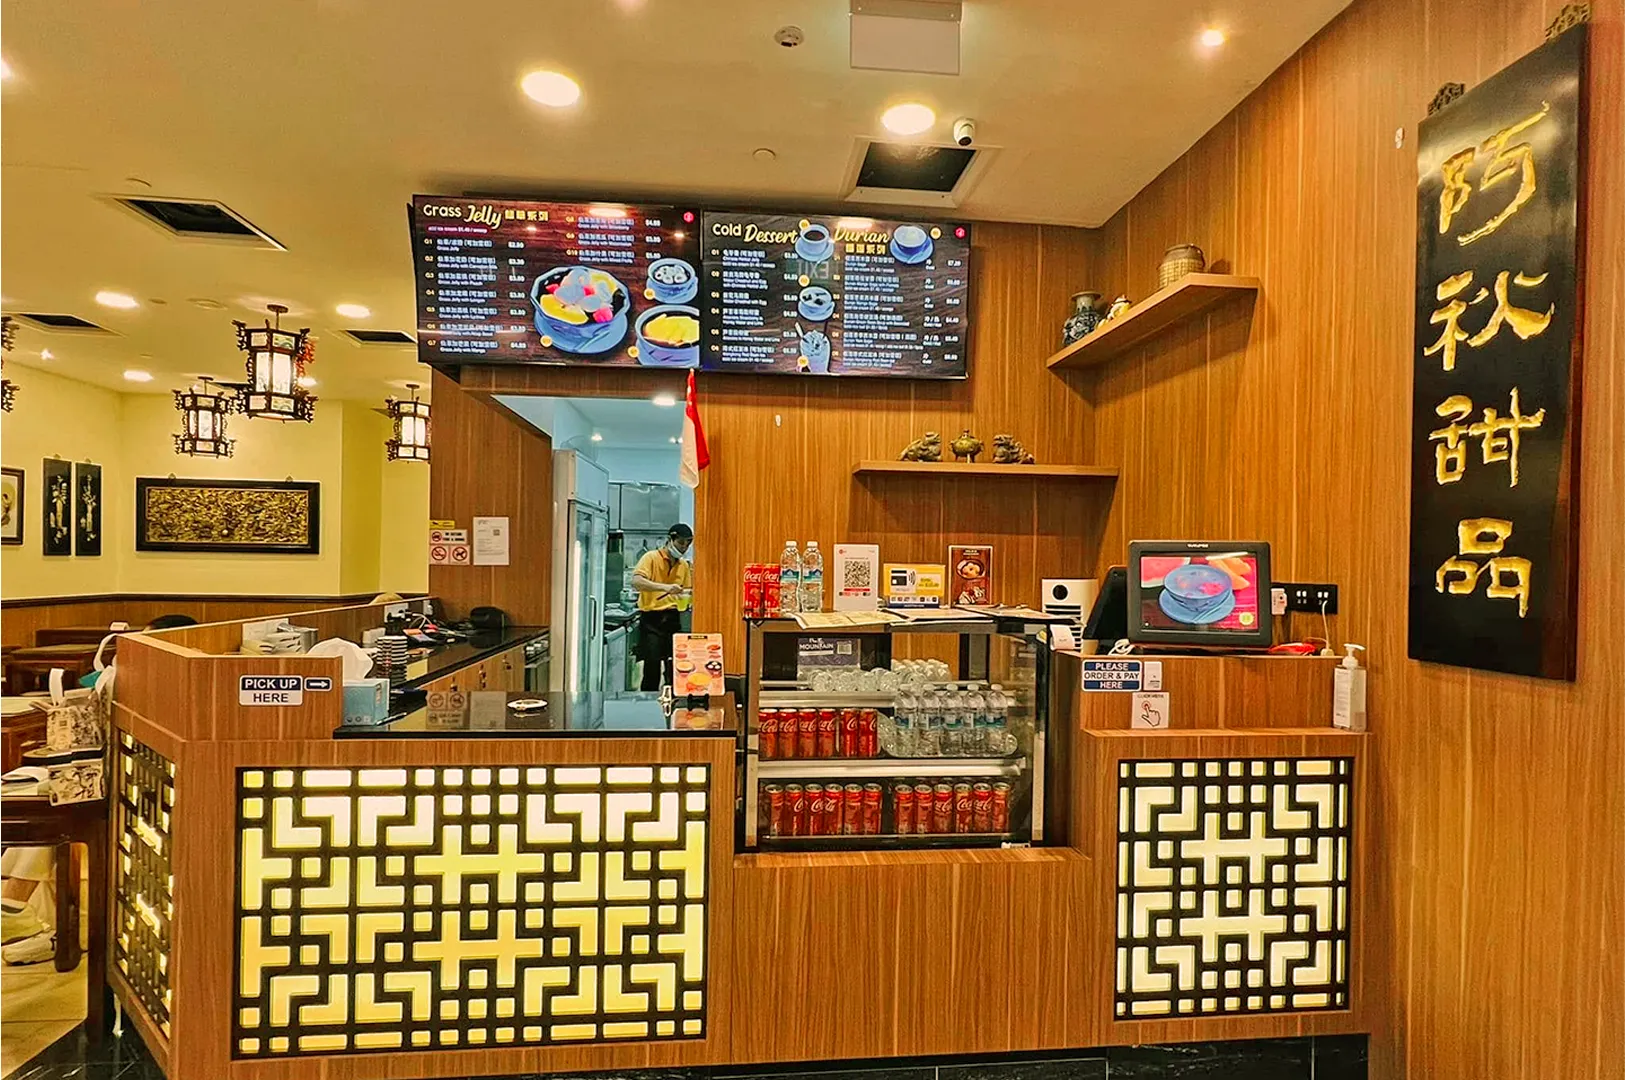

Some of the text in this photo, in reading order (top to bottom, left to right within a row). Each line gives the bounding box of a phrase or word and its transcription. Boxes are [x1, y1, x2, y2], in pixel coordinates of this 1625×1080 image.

[423, 204, 502, 229] Grass Jelly
[712, 223, 798, 244] Cold Dessert
[834, 222, 890, 243] Durian
[1096, 663, 1129, 671] PLEASE
[1084, 672, 1114, 680] ORDER
[1116, 672, 1122, 680] &
[245, 679, 298, 689] PICK UP
[1100, 681, 1123, 689] HERE
[253, 693, 289, 703] HERE
